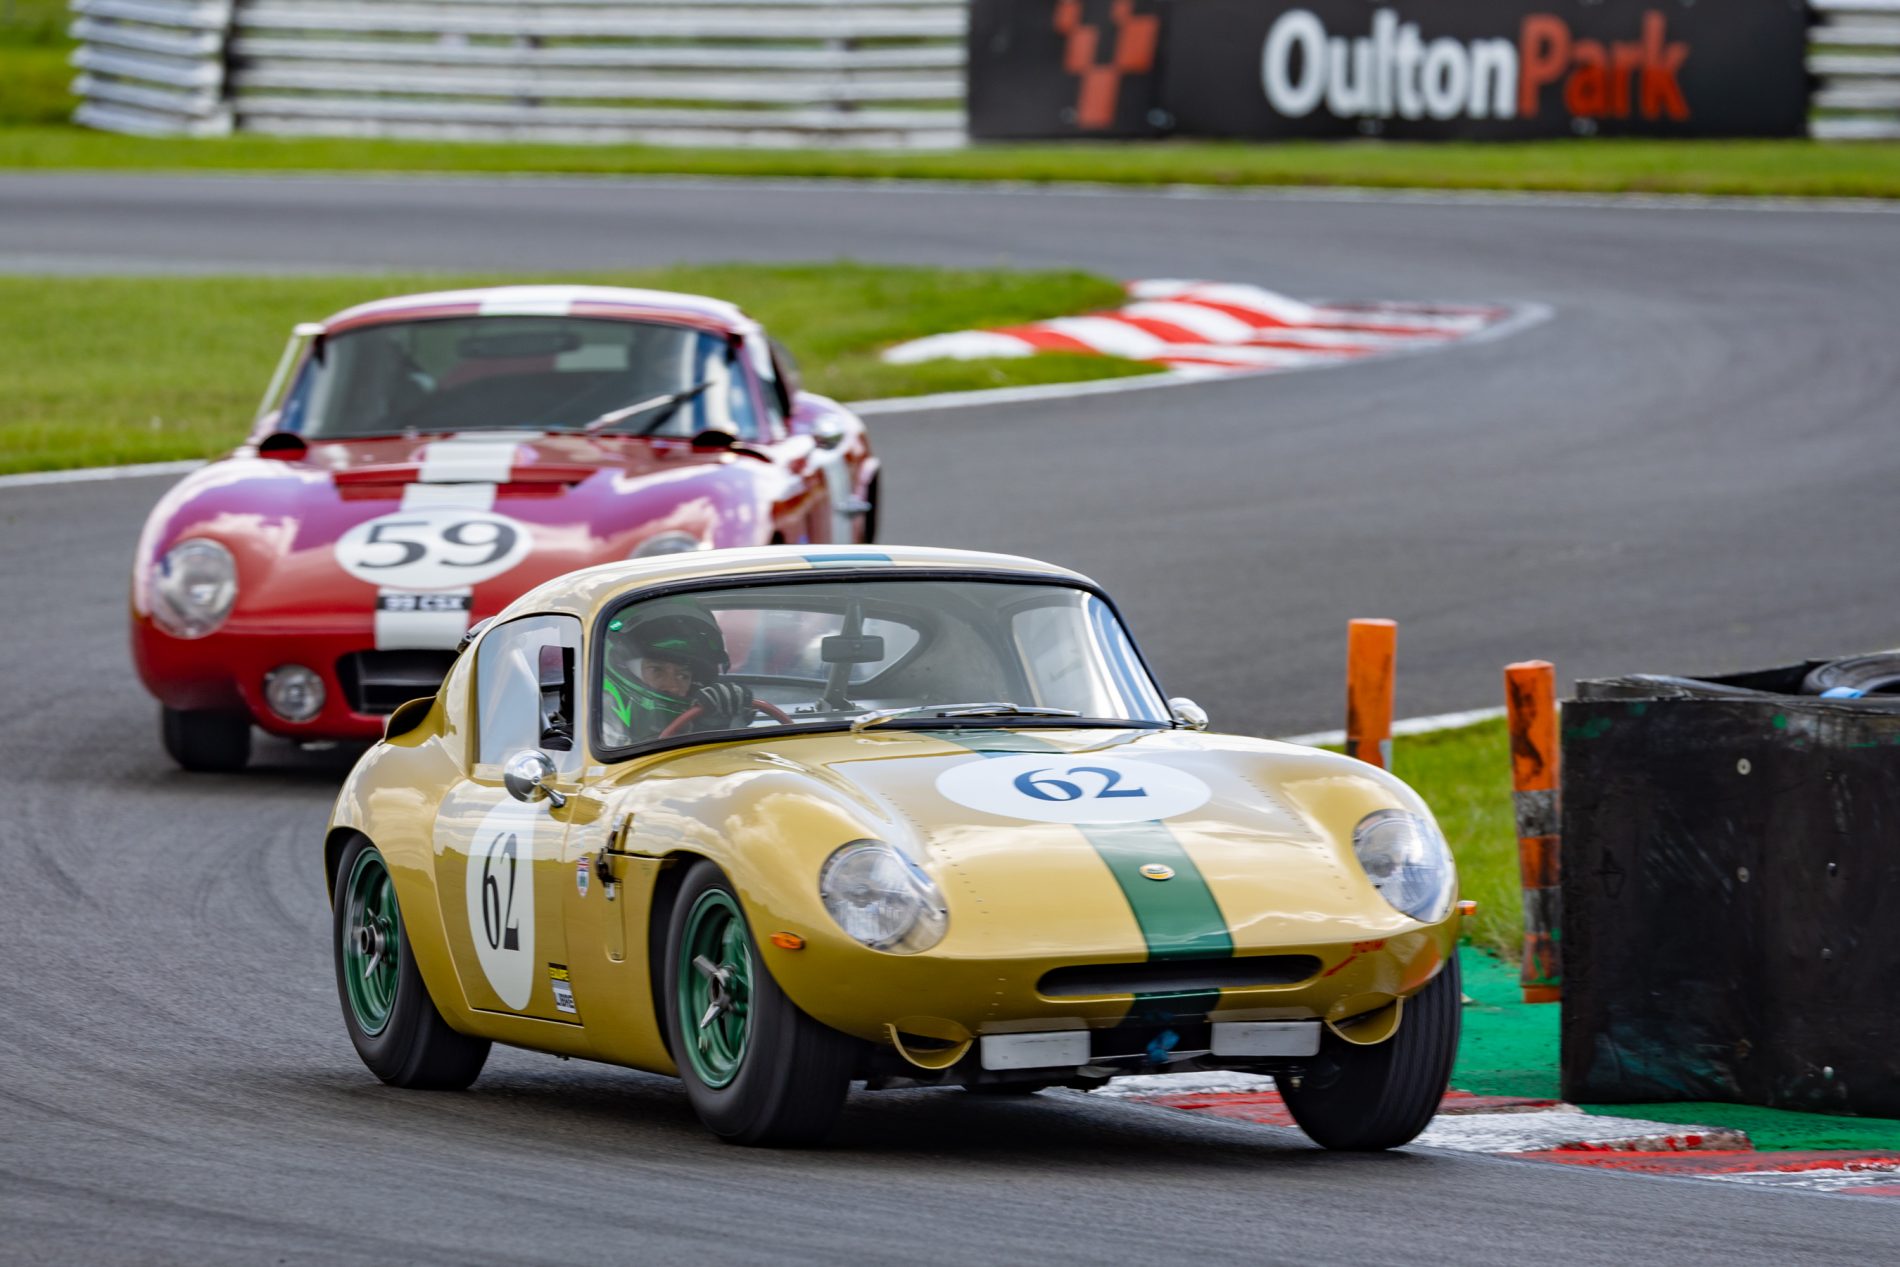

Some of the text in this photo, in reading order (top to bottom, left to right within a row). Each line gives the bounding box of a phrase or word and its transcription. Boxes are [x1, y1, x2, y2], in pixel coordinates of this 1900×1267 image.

[357, 520, 517, 568] 59
[1012, 766, 1148, 801] 62
[482, 832, 520, 952] 62
